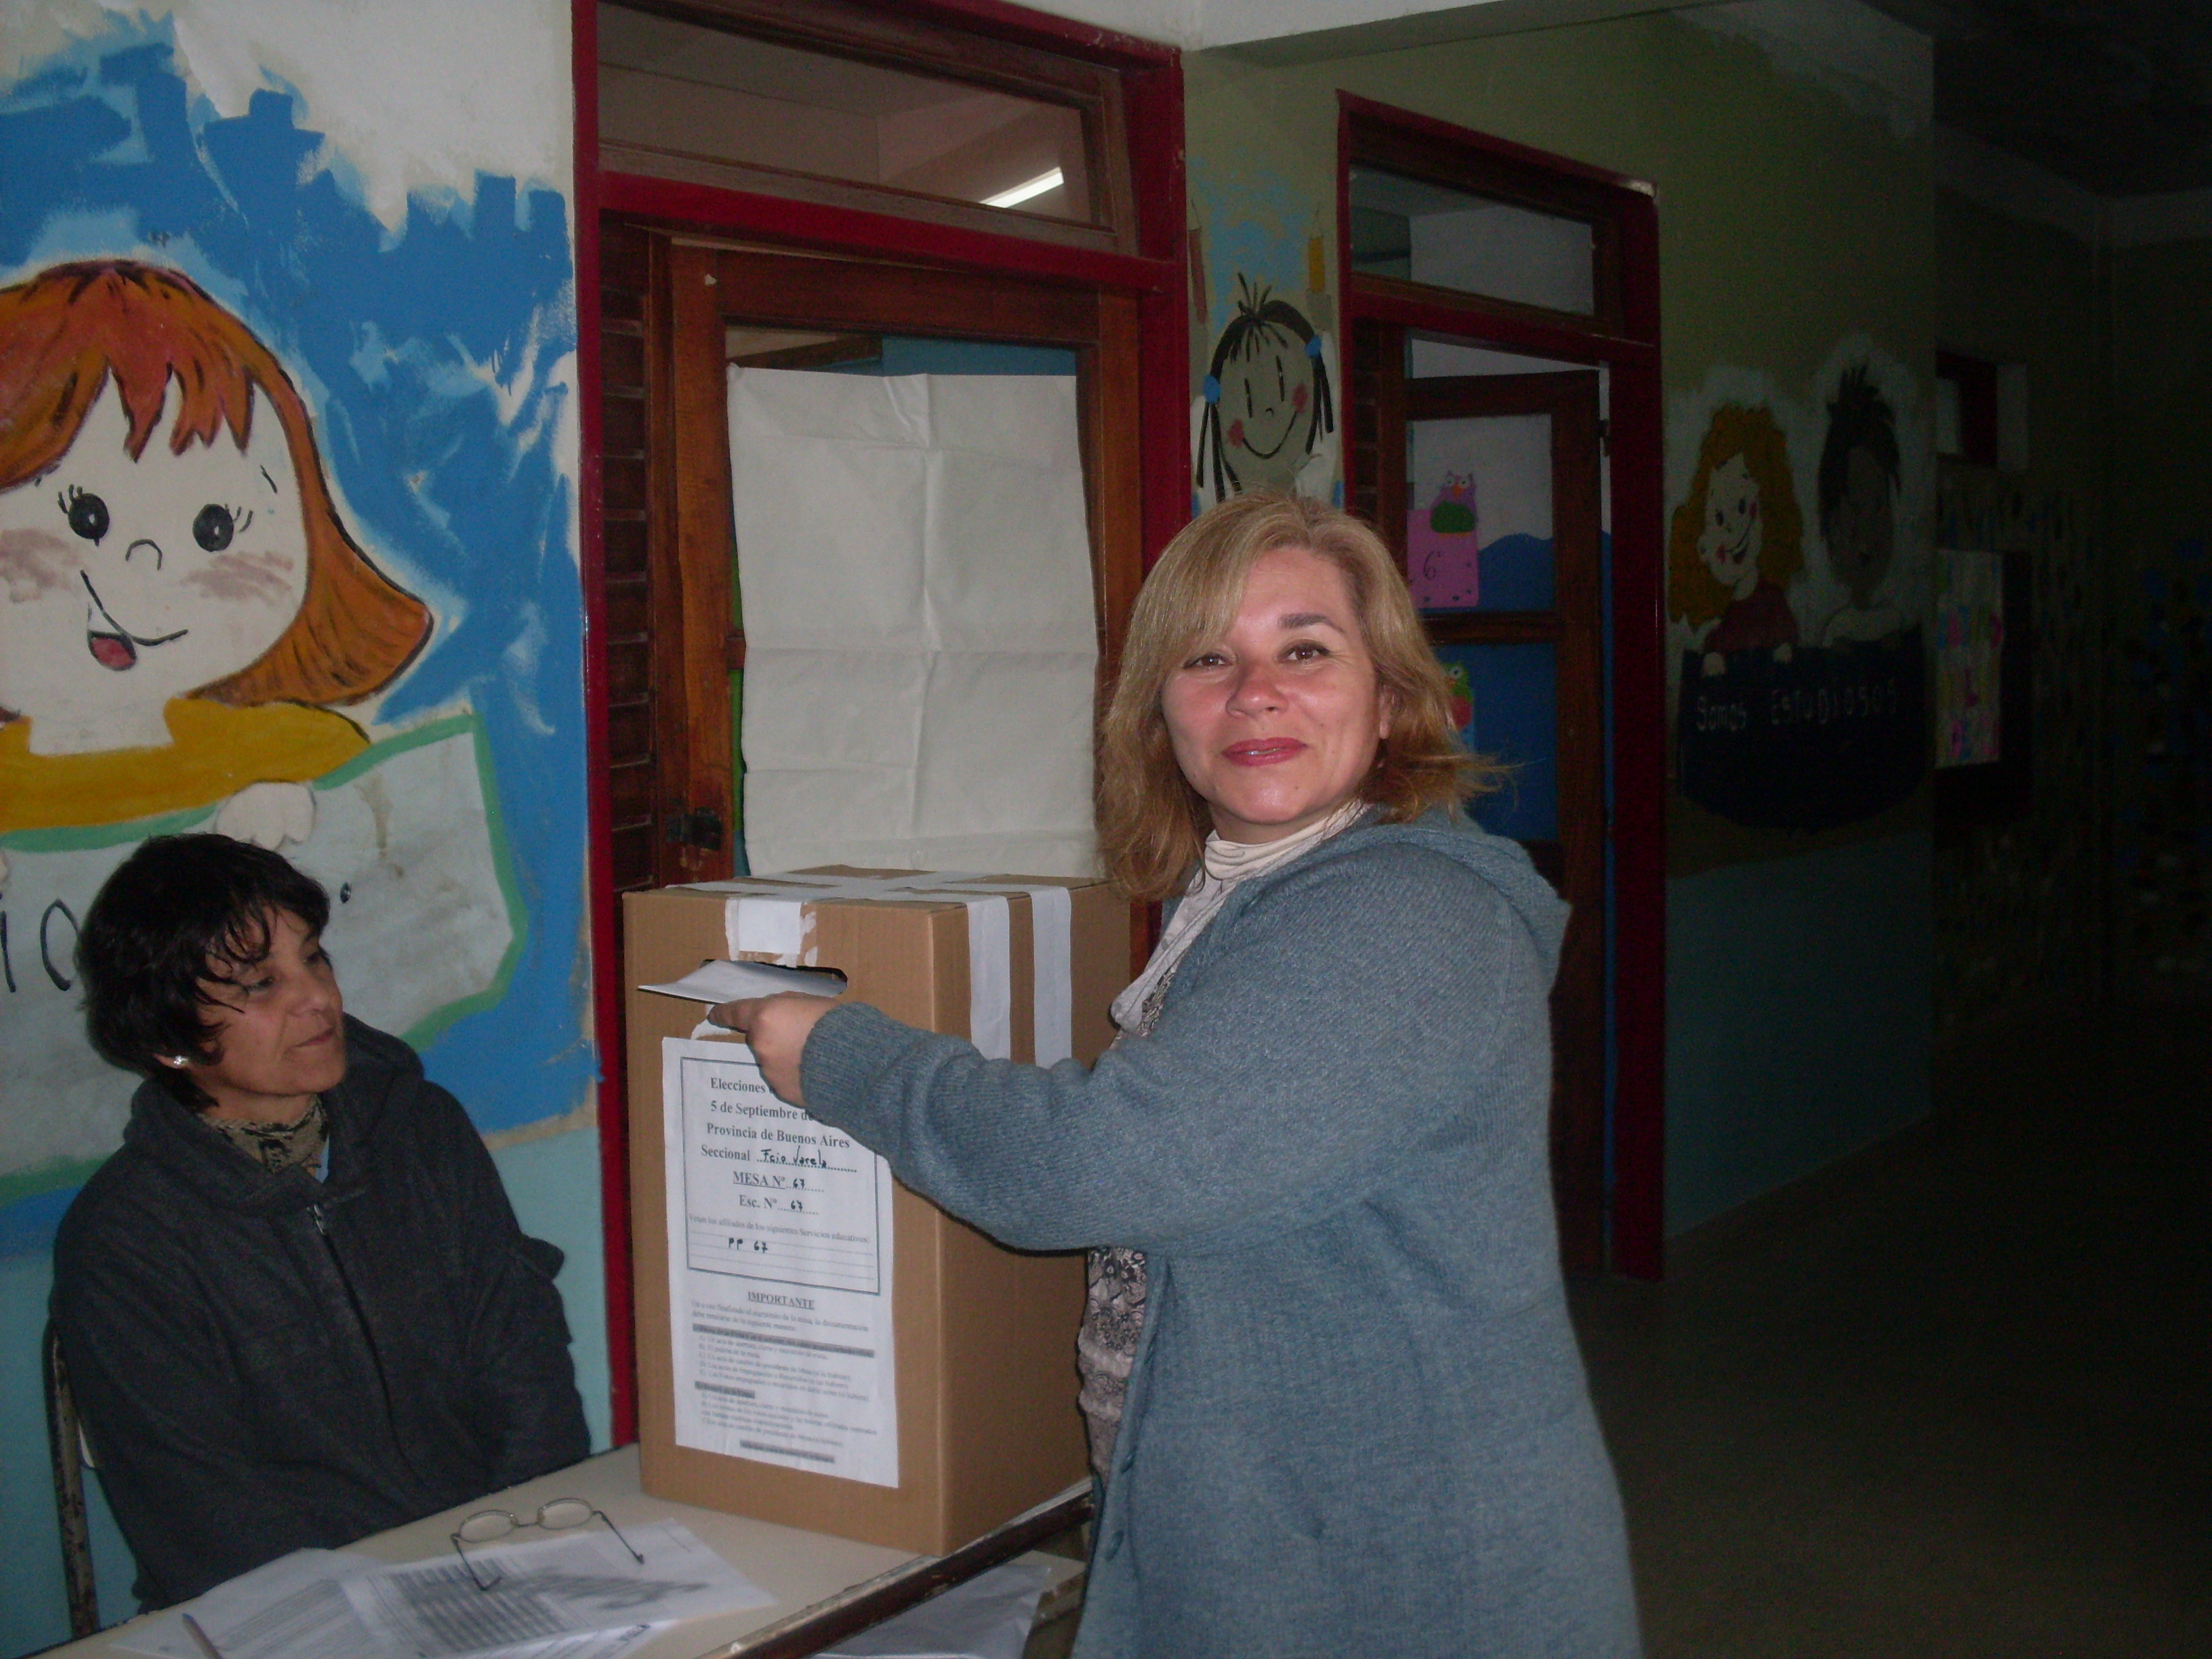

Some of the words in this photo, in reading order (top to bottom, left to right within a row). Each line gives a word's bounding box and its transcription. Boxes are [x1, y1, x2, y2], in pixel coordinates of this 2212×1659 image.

[710, 1077, 766, 1093] Elecciones
[711, 1101, 716, 1111] 5
[720, 1101, 733, 1114] de
[736, 1103, 798, 1119] Septiembre
[707, 1122, 757, 1139] Provincia
[761, 1128, 773, 1141] de
[777, 1130, 817, 1145] Buenos
[820, 1135, 850, 1148] Aires
[701, 1144, 750, 1161] Seccional
[733, 1171, 769, 1186] MESA
[792, 1178, 805, 1189] 67
[739, 1195, 760, 1208] Esc.
[790, 1200, 803, 1212] 67
[799, 1229, 830, 1239] Servicios
[753, 1240, 769, 1253] 67
[747, 1291, 815, 1309] IMPORTANTE
